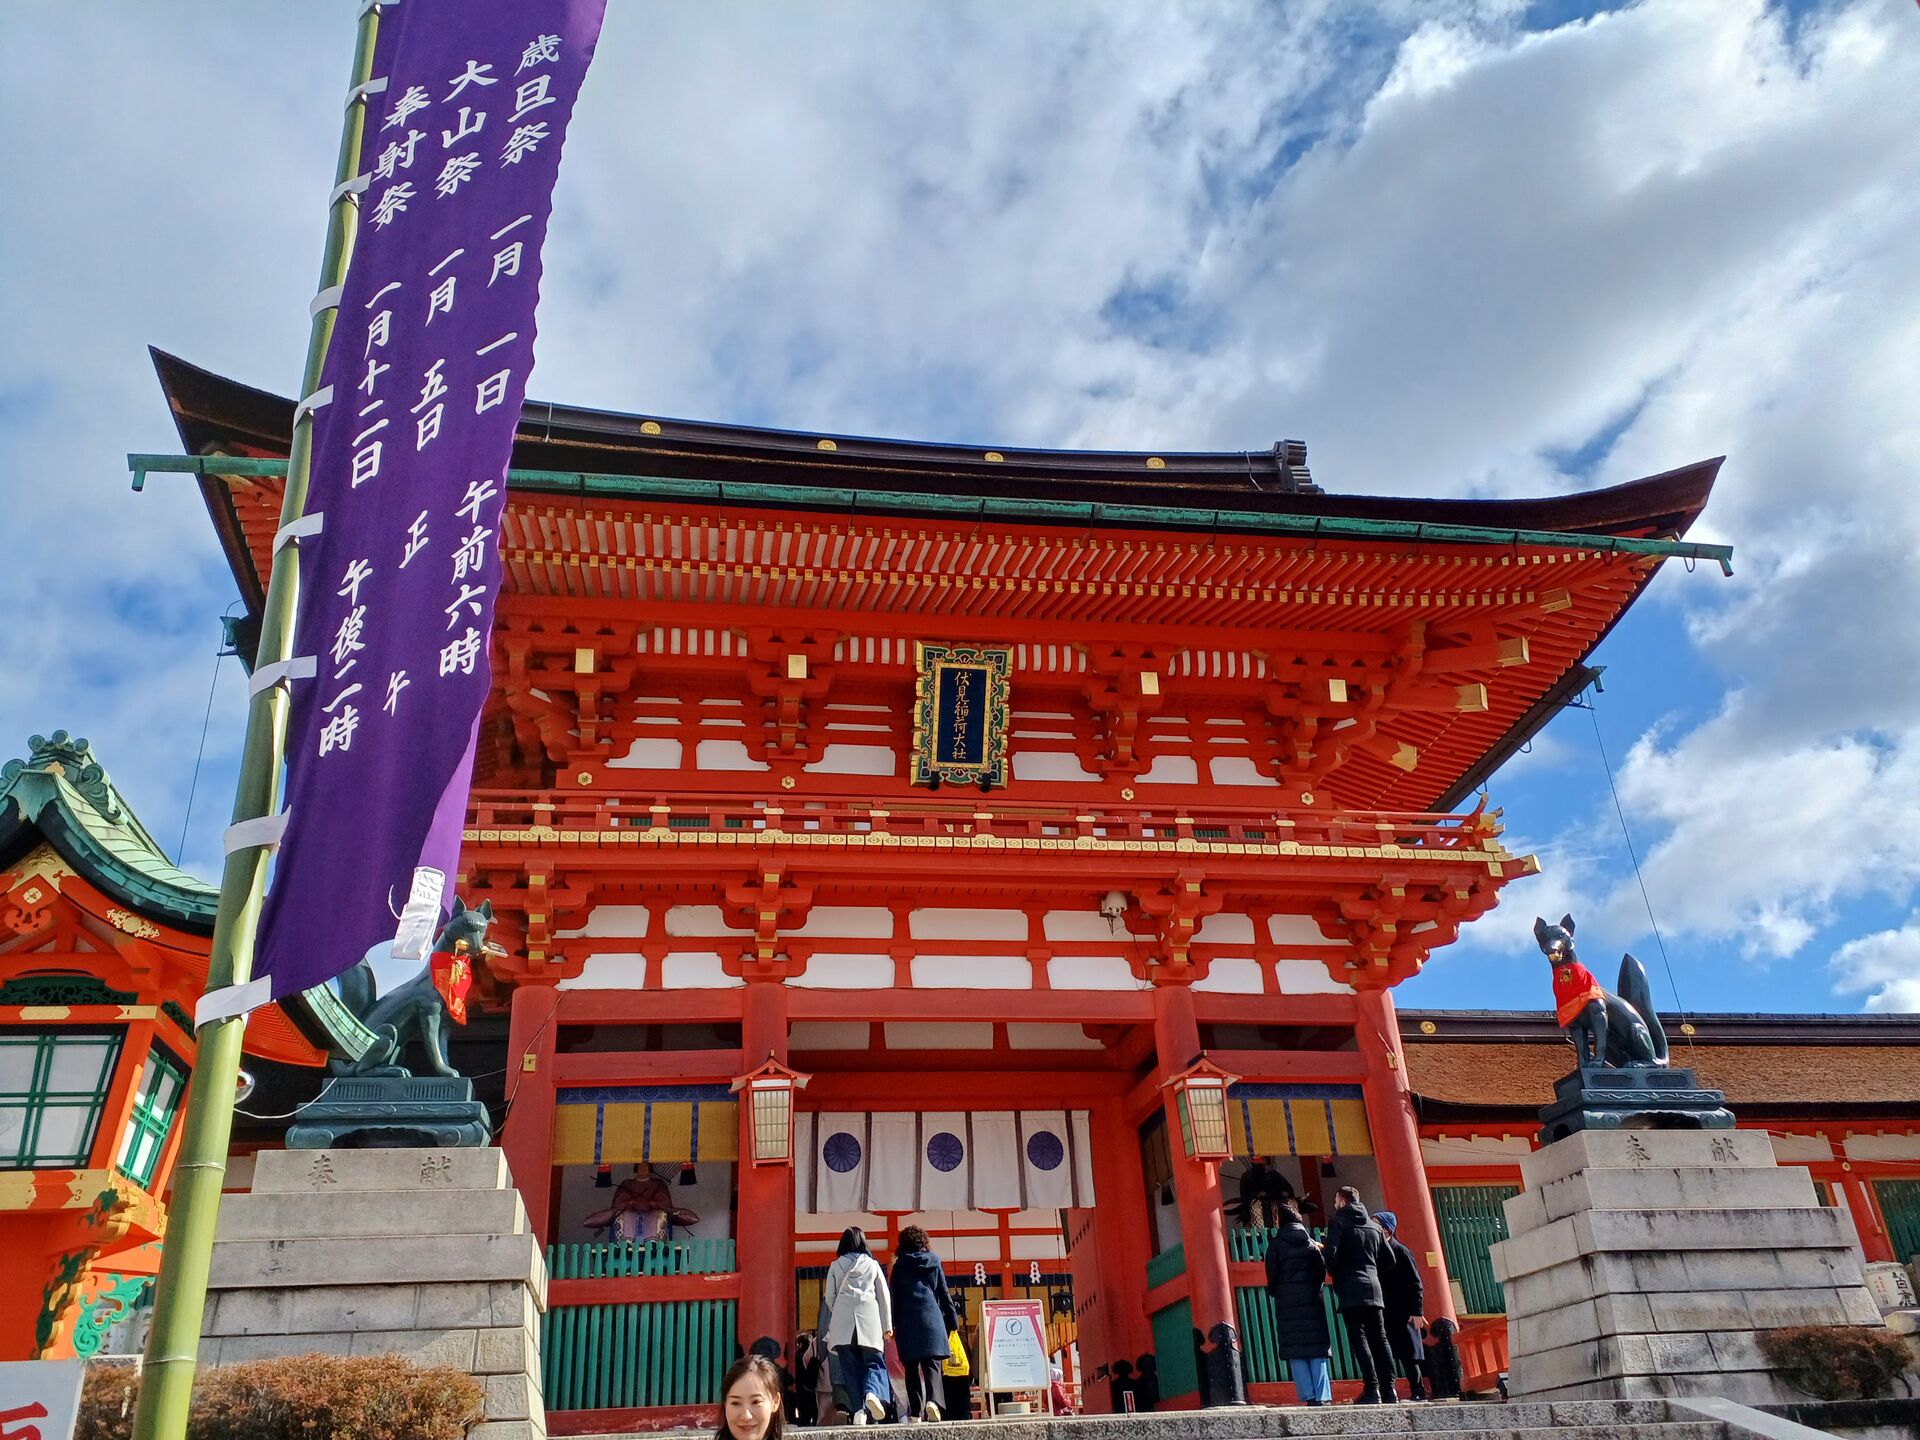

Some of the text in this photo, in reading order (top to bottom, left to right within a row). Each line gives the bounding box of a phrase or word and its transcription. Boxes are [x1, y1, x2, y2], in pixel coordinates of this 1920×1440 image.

[368, 83, 431, 232] 奉射祭
[435, 59, 499, 200] 大山祭
[498, 34, 562, 169] 歳旦祭
[439, 479, 498, 678] 午前六時
[318, 558, 374, 758] 午後二時
[952, 671, 972, 760] 伏見稲荷大社
